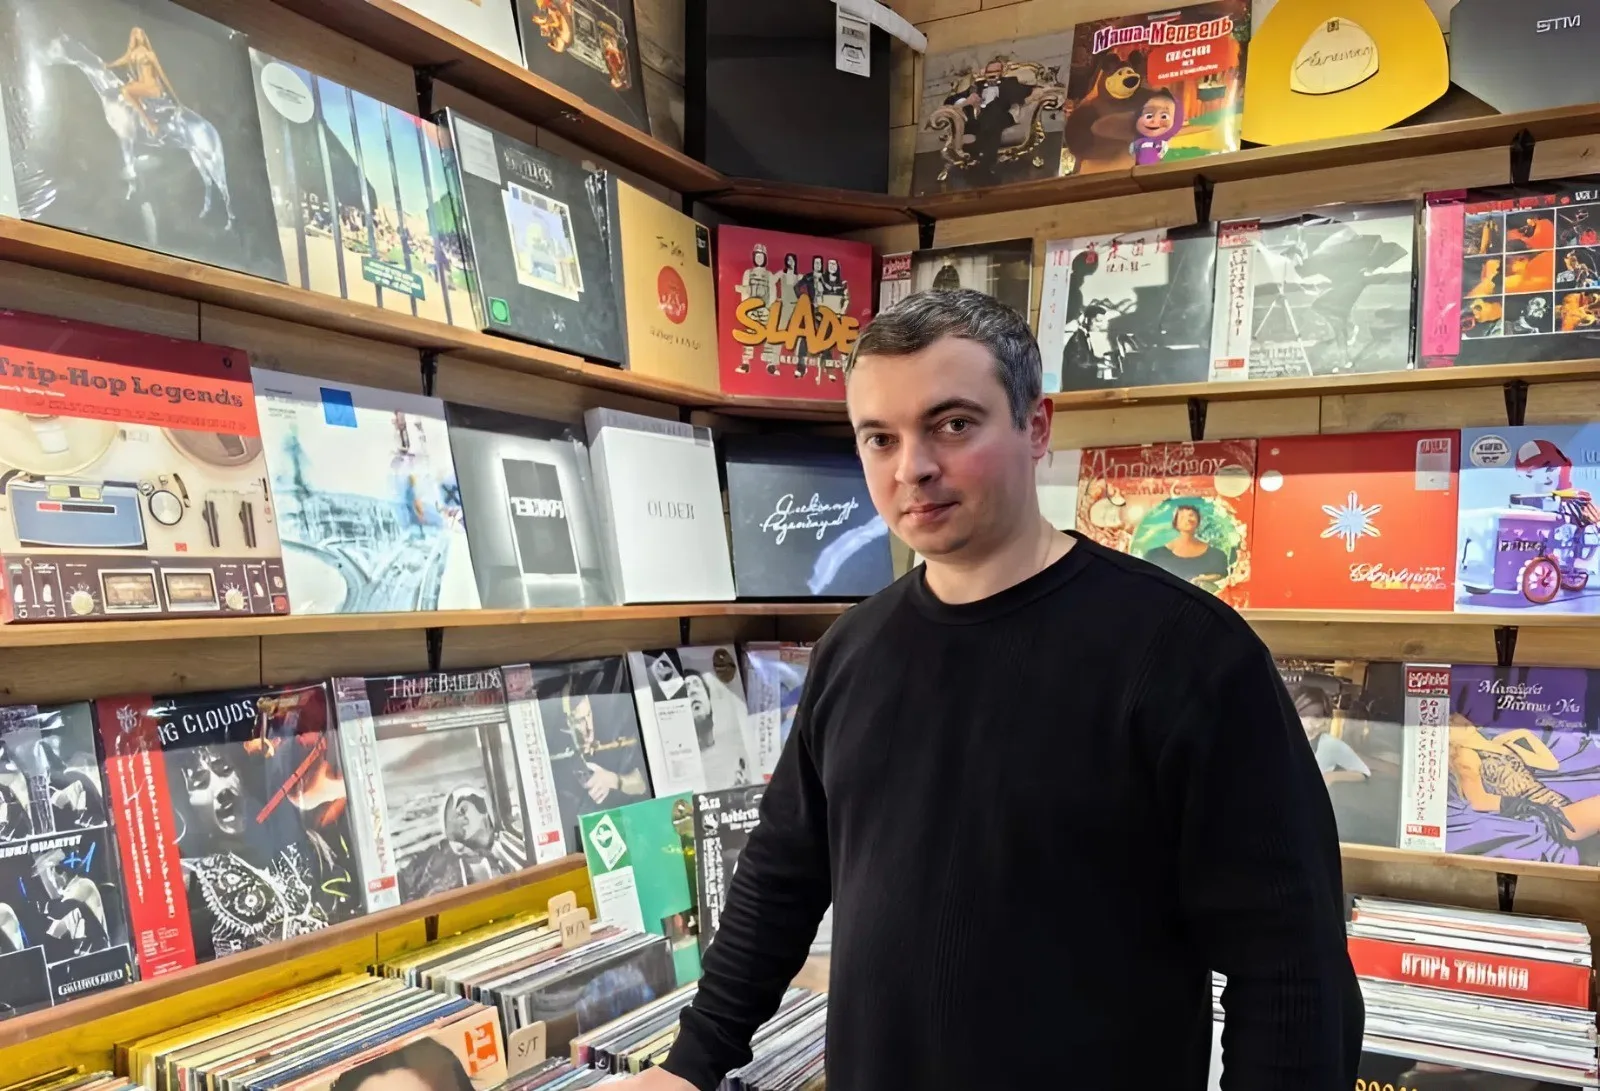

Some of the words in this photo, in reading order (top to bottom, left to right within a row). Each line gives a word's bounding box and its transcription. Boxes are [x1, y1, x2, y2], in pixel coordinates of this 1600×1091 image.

[732, 293, 860, 355] SLADE
[0, 357, 127, 396] Trip-Hop
[131, 376, 243, 407] Legends
[647, 500, 695, 520] OLDER
[182, 700, 255, 734] CLOUDS
[517, 1036, 544, 1057] S/T
